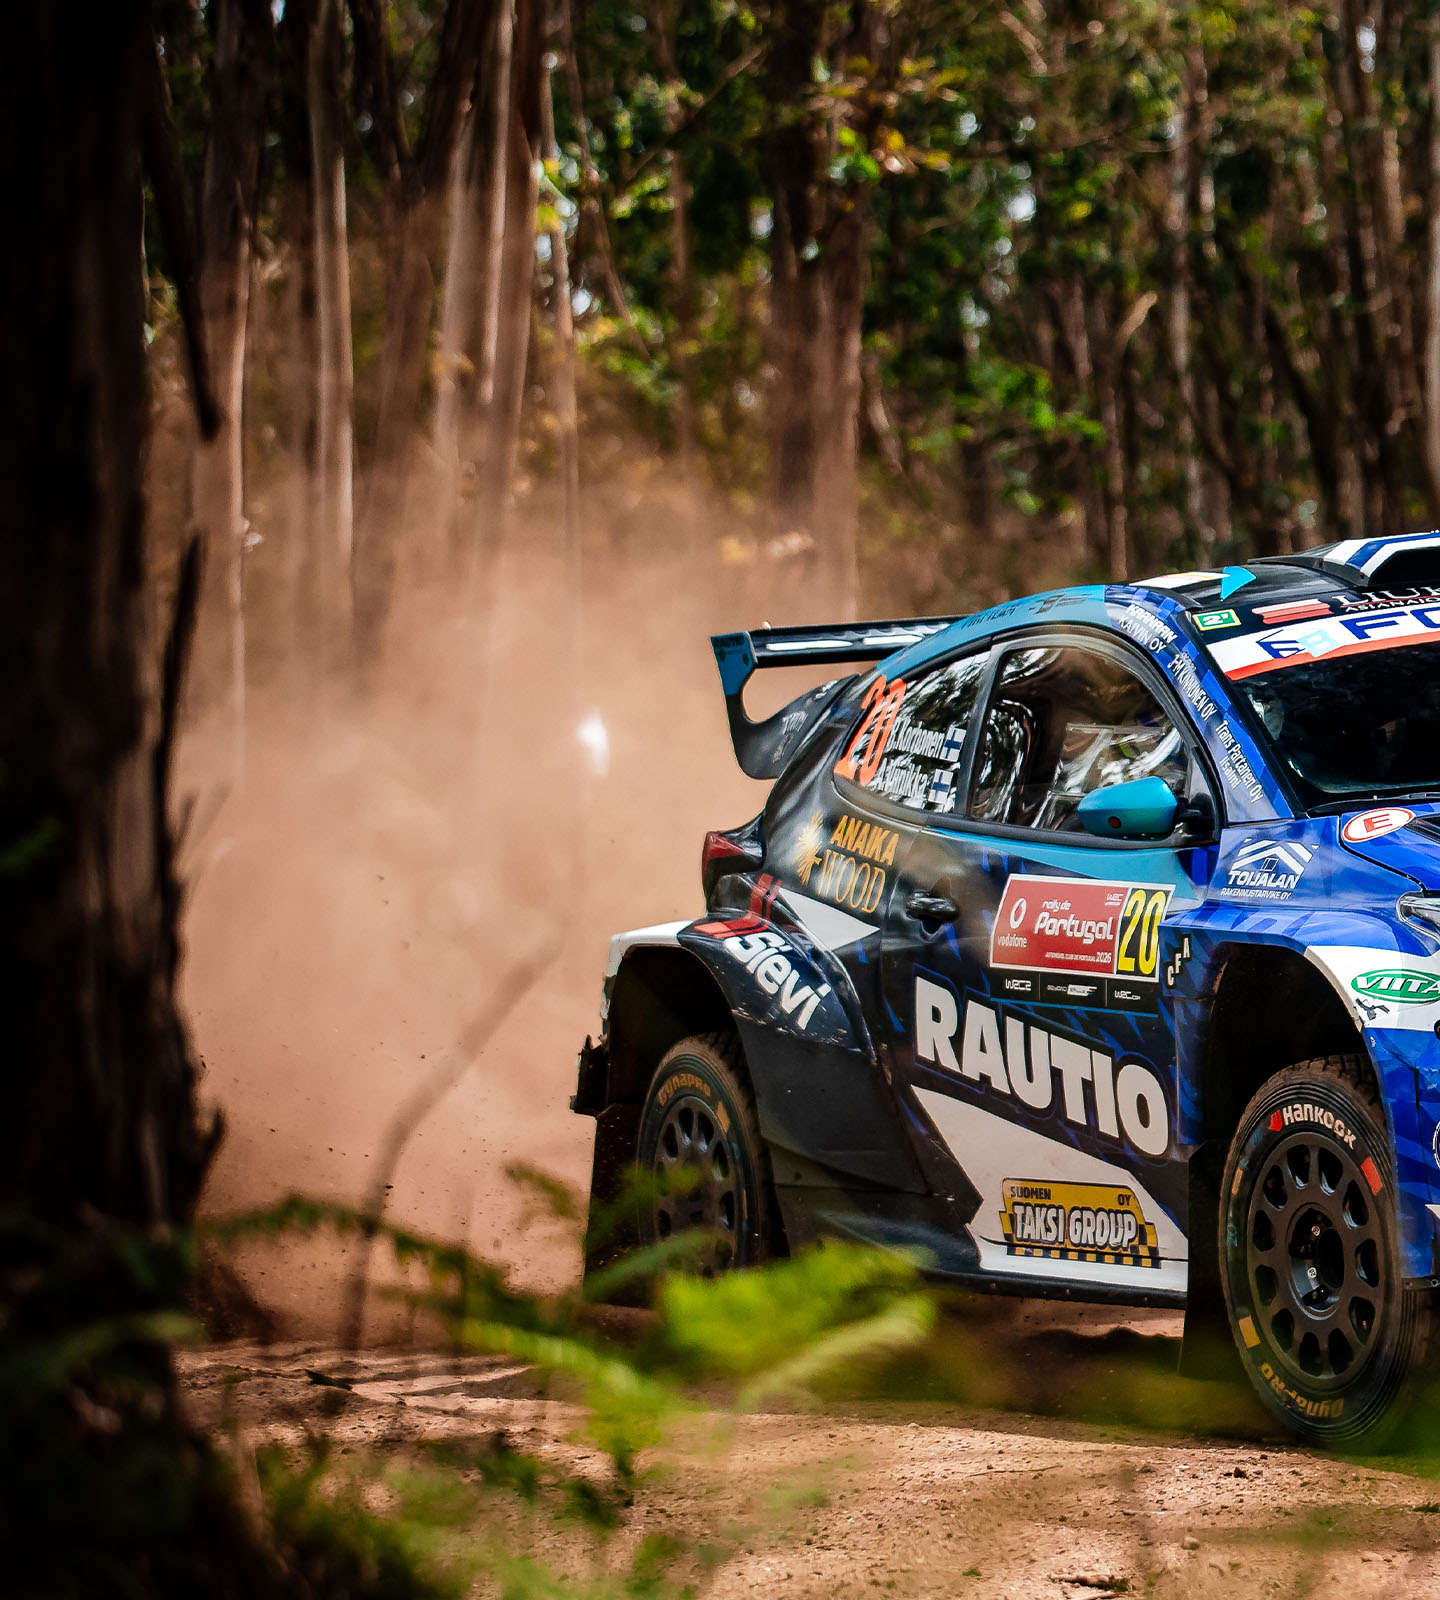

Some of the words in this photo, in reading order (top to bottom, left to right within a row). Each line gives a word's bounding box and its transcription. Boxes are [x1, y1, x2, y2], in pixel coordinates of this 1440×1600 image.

[1119, 615, 1150, 646] KAIVIN
[1148, 638, 1167, 654] OY
[833, 675, 906, 785] 20
[1201, 702, 1217, 721] OY
[1216, 719, 1233, 749] Trans
[1228, 744, 1256, 790] Partanen
[1249, 784, 1265, 804] Oy
[829, 815, 900, 867] ANAIKA
[816, 849, 886, 914] WOOD
[1220, 887, 1281, 899] RAKENNUSTARVIKE
[1228, 871, 1300, 889] TOIJALAN
[1042, 899, 1060, 912] rally
[1060, 900, 1072, 910] de
[997, 934, 1028, 949] vodafone
[1034, 911, 1114, 945] Portugal
[1117, 889, 1167, 975] 20
[1096, 951, 1112, 964] 2026
[723, 931, 832, 1030] Sievi
[916, 976, 1169, 1156] RAUTIO
[1010, 1186, 1052, 1201] SUOMEN
[1117, 1193, 1132, 1206] OY
[1012, 1203, 1066, 1244] TAKSI
[1069, 1208, 1138, 1250] GROUP
